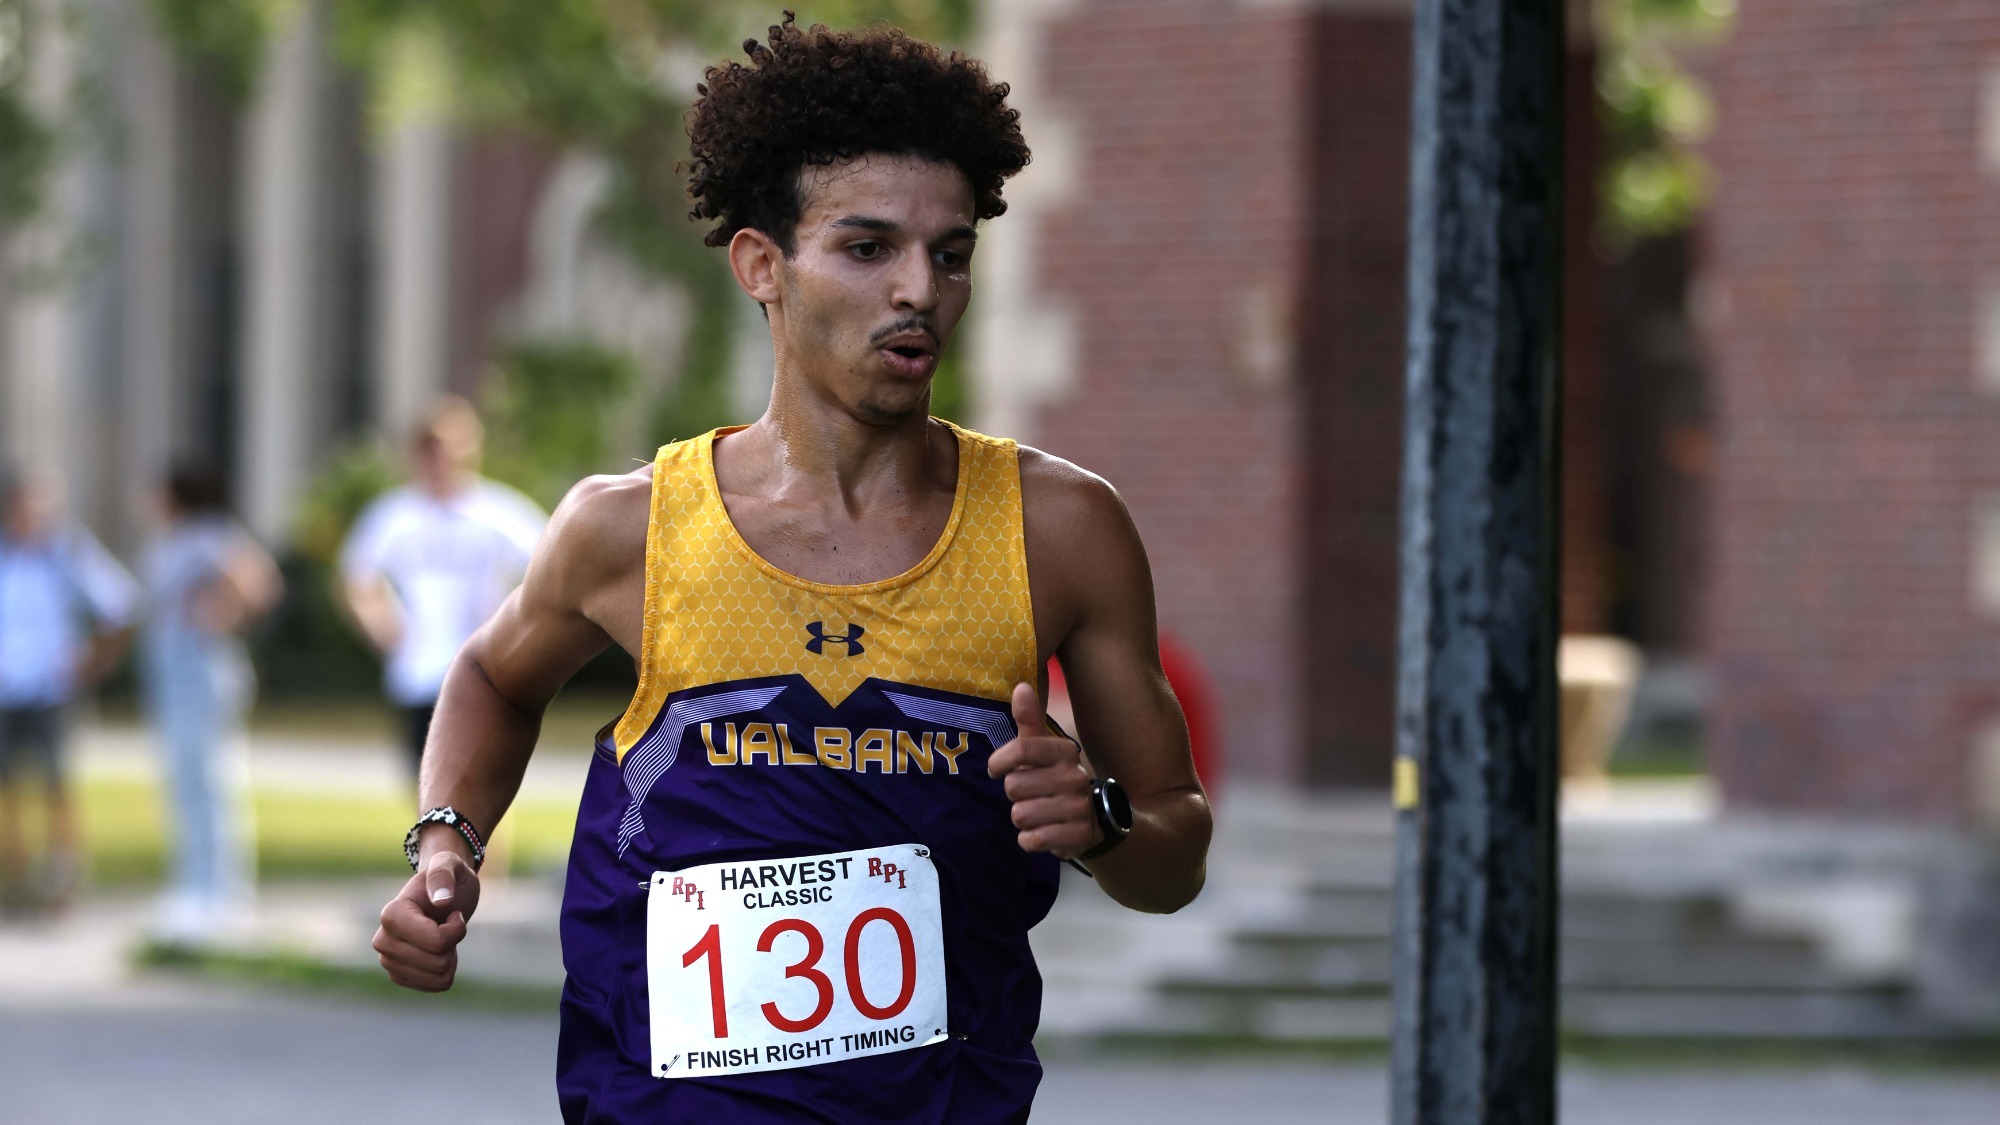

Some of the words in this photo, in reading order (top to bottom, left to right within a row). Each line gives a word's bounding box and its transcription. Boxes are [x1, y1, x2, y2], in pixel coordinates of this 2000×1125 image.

[701, 722, 969, 774] UALBANY
[720, 857, 853, 890] HARVEST
[867, 857, 907, 889] RPI
[743, 886, 833, 909] CLASSIC
[682, 907, 917, 1039] 130
[687, 1048, 759, 1070] FINISH
[766, 1038, 834, 1062] RIGHT
[840, 1025, 915, 1052] TIMING
